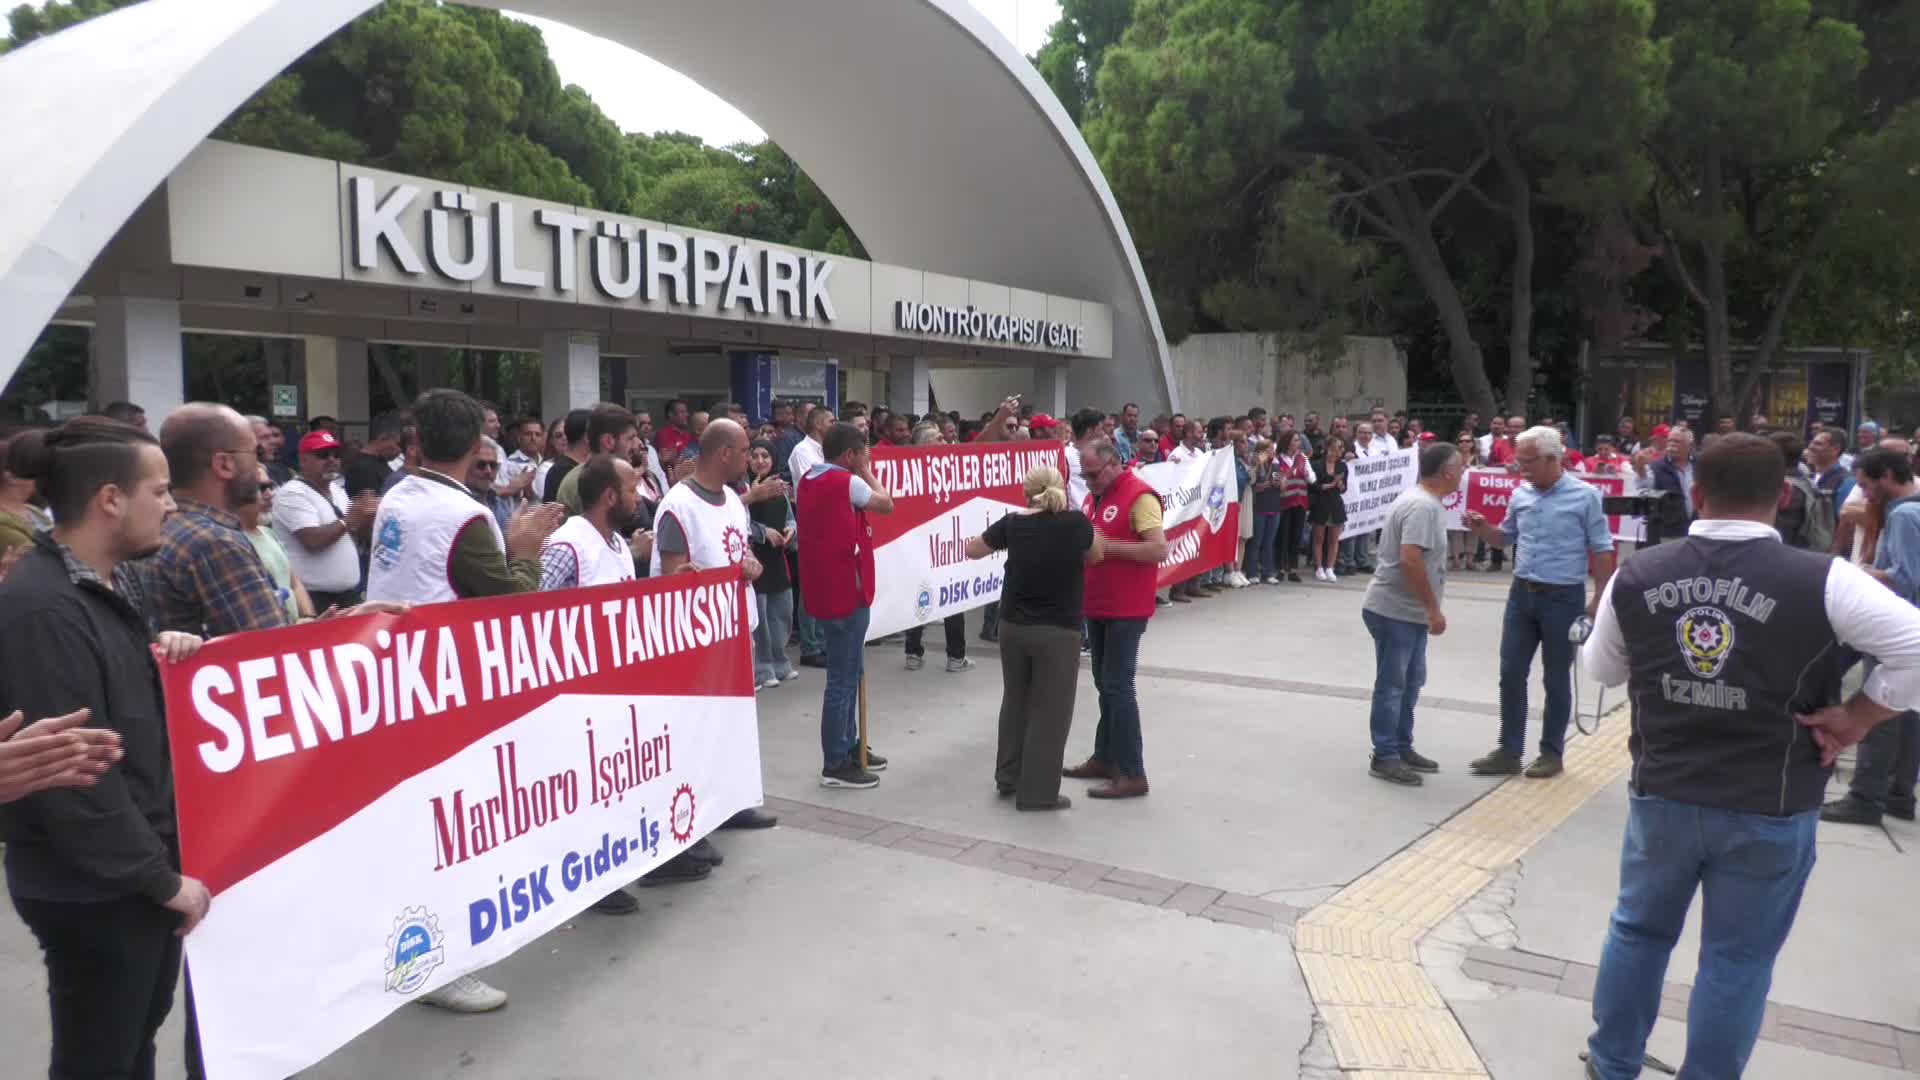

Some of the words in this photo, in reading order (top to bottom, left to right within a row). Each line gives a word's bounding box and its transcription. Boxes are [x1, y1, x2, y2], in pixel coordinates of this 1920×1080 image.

[351, 176, 837, 321] KÜLTÜRPARK
[896, 300, 983, 337] MONTRÖ
[986, 312, 1038, 344] KAPISI
[1048, 322, 1085, 348] GATE
[869, 455, 924, 498] TILAN
[1643, 576, 1777, 625] FOTOFİLM
[473, 600, 599, 701] HAKKI
[602, 580, 740, 668] TANINSIN!
[1661, 672, 1747, 711] İZMİR
[429, 740, 579, 872] Marlboro
[585, 703, 673, 809] İşçileri
[467, 864, 555, 947] DİSK
